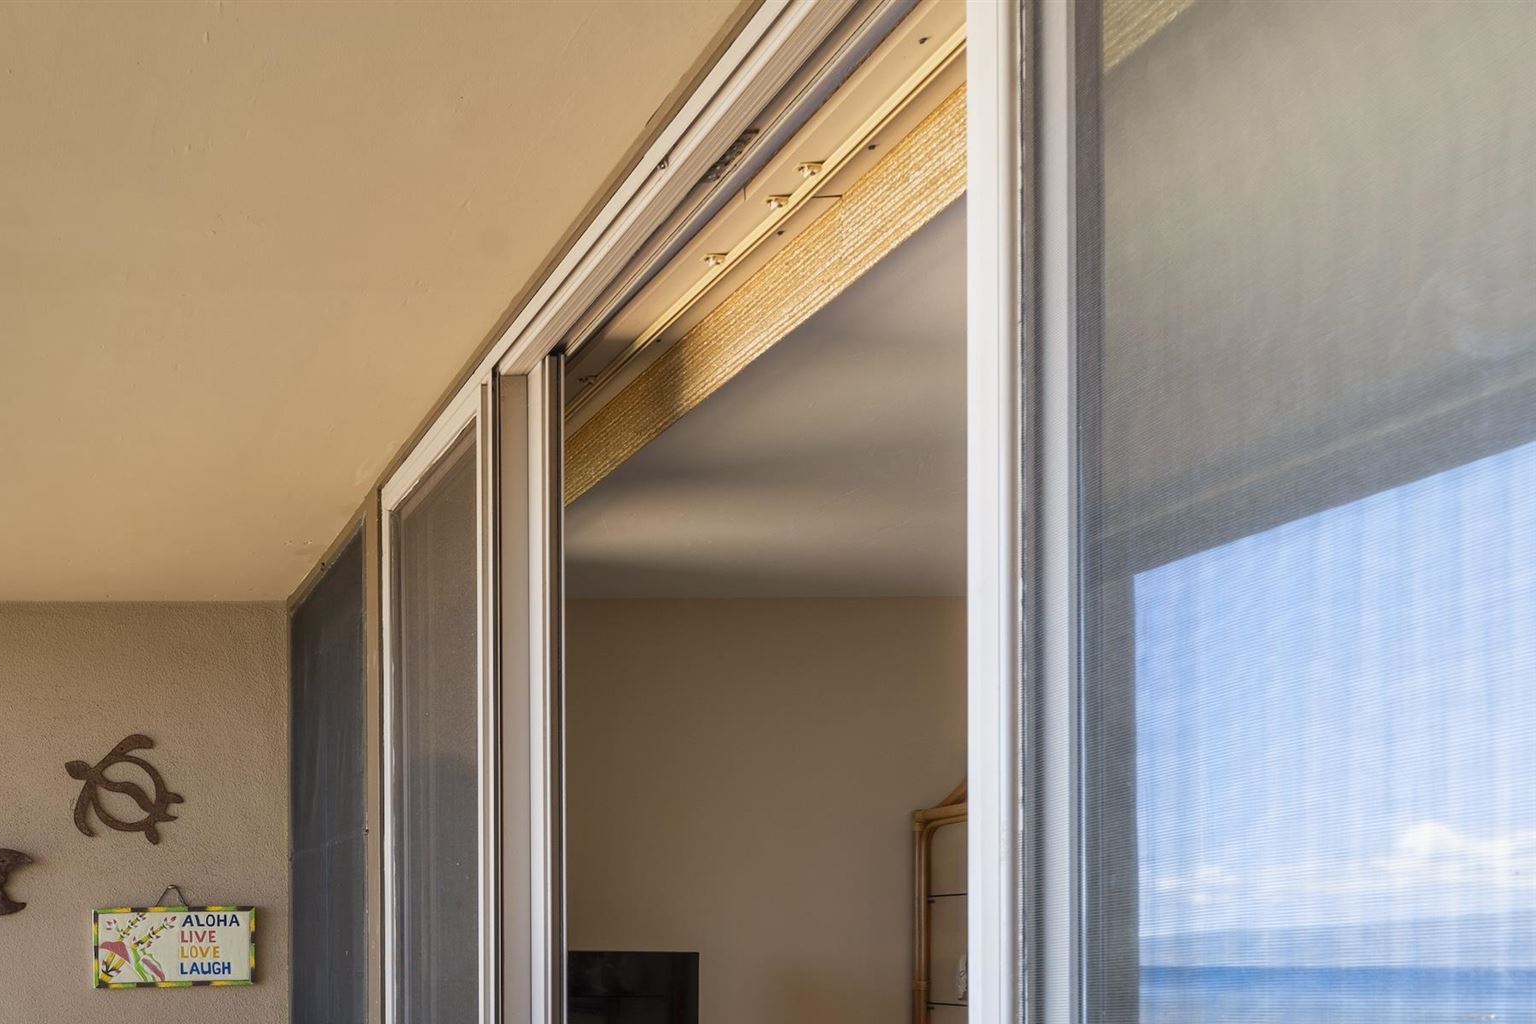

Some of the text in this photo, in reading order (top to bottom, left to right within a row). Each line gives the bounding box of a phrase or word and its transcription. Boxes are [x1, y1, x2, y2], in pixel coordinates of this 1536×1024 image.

[182, 914, 240, 927] ALOHA
[180, 930, 216, 943] LIVE
[180, 945, 220, 959] LOVE
[180, 961, 231, 975] LAUGH
